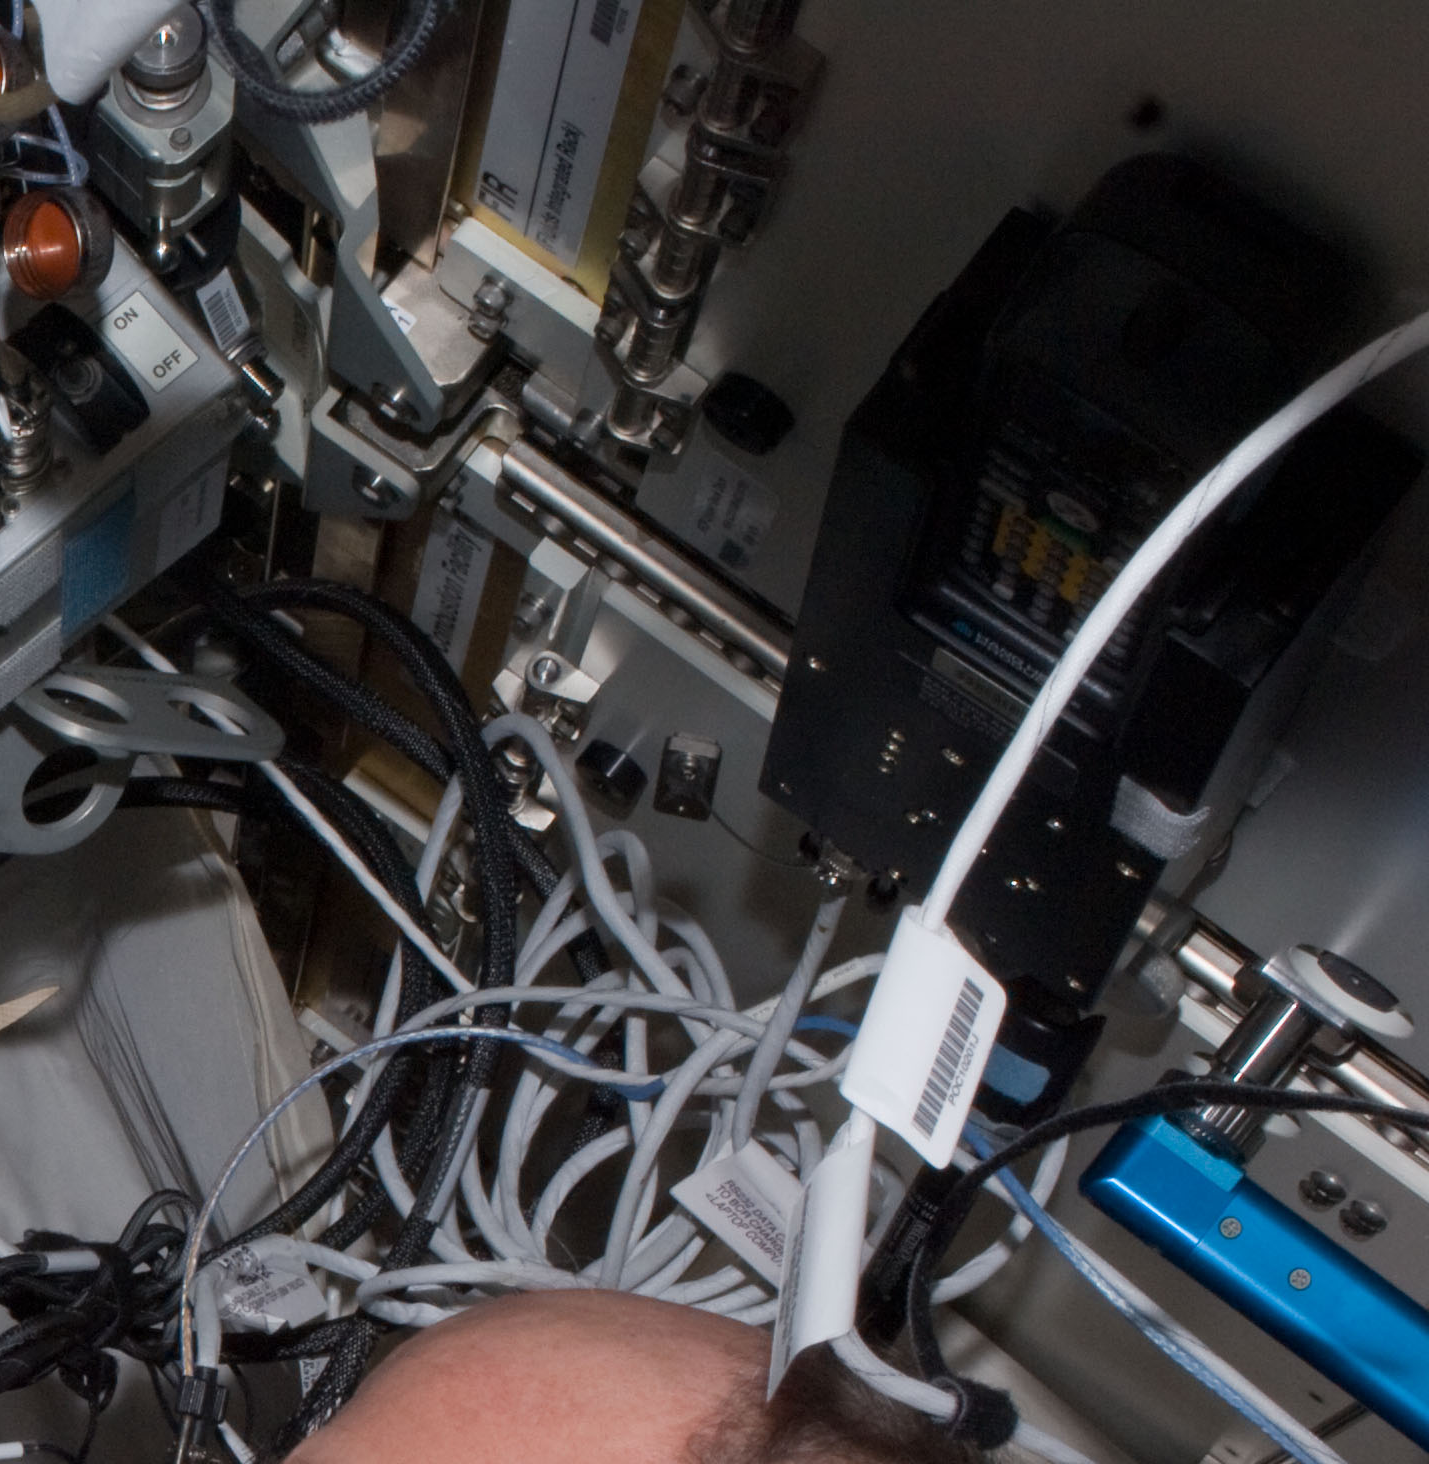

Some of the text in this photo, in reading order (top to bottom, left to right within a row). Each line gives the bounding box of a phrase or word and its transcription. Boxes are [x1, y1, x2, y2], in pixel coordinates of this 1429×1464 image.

[475, 170, 519, 221] FIR
[111, 306, 138, 331] ON
[150, 348, 184, 379] OFF
[716, 1184, 731, 1199] TO
[728, 1197, 751, 1219] BCR
[751, 1208, 777, 1233] DATA
